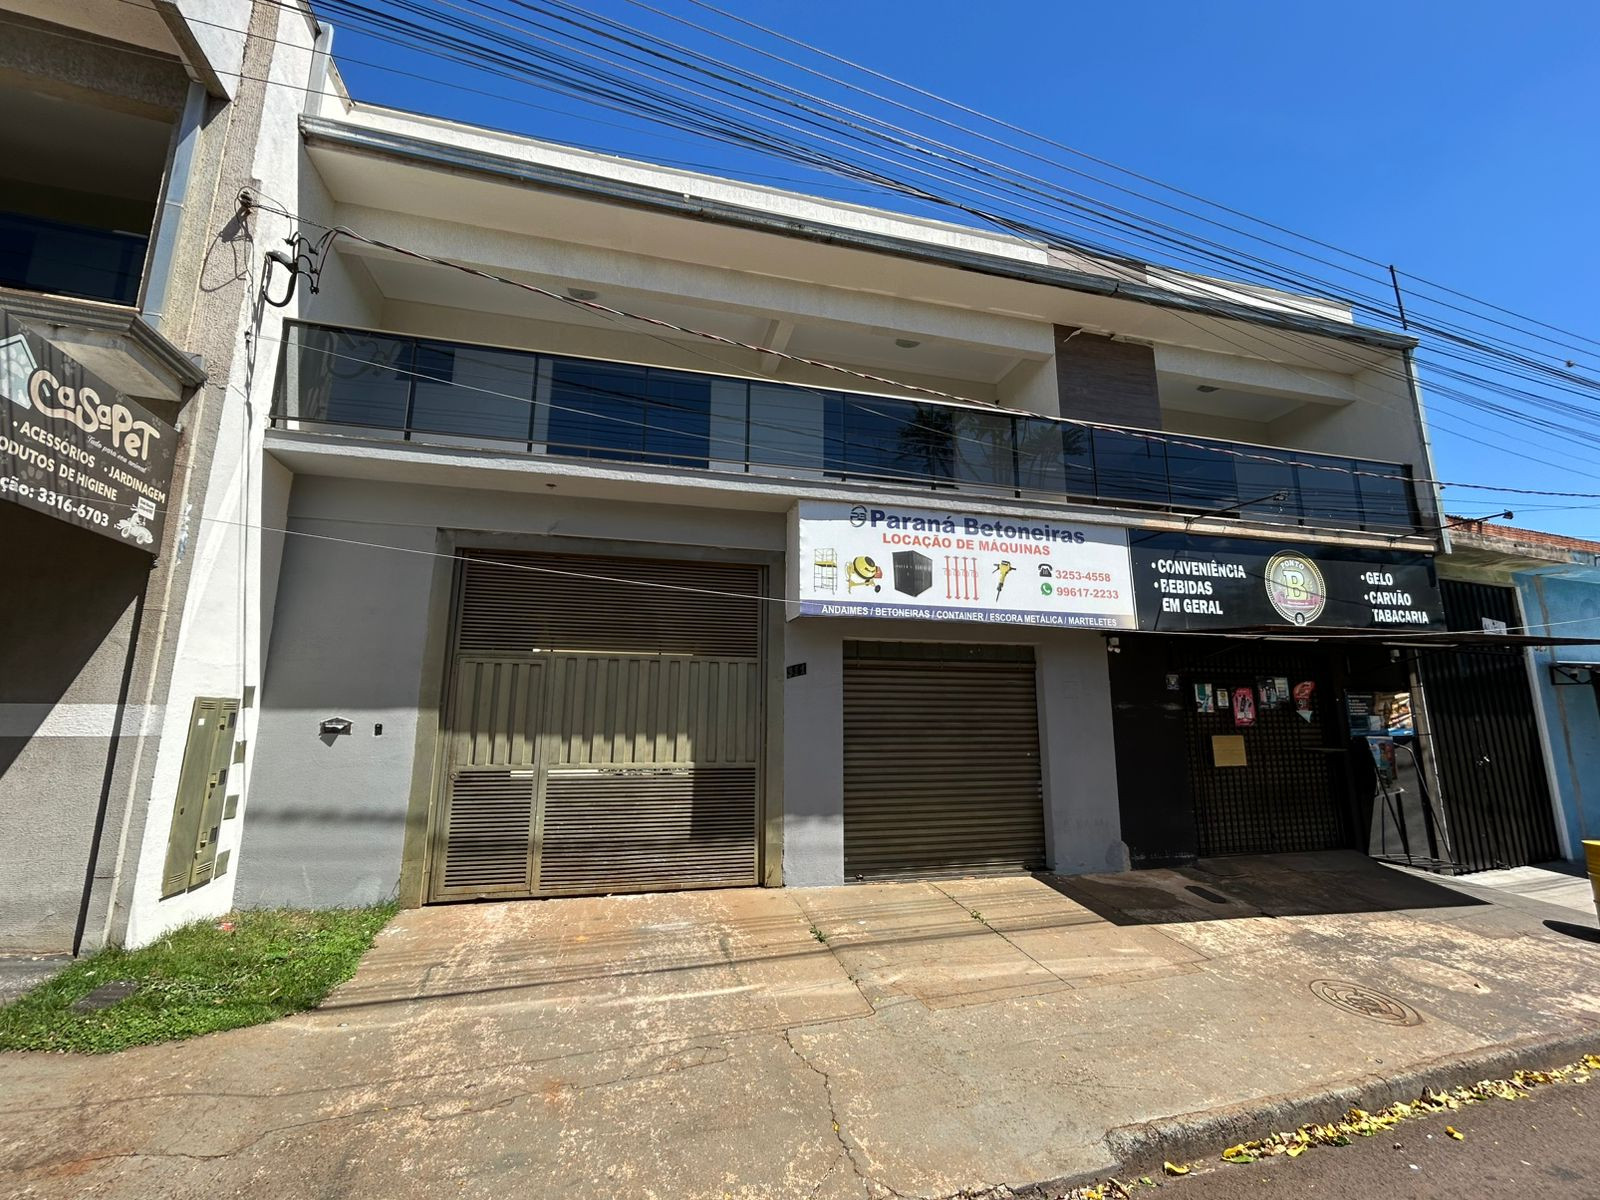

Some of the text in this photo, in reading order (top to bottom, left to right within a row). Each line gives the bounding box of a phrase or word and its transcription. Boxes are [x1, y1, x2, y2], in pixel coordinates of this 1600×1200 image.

[19, 421, 166, 504] ACESSÓRIOS JARDINAGEM
[58, 463, 76, 482] DE
[76, 471, 118, 501] HIGIENE
[37, 486, 110, 527] 3316-6703
[870, 509, 955, 534] Paraná
[963, 517, 1085, 545] Betoneiras
[882, 533, 1050, 556] LOCAÇÃO DE MÁQUINAS
[1055, 569, 1111, 583] 3253-4558
[1157, 559, 1247, 579] CONVENIÊNCIA
[1366, 571, 1394, 586] GELO
[1056, 586, 1119, 600] 99617-2233
[1160, 579, 1214, 595] BEBIDAS
[1282, 569, 1309, 601] B
[1162, 597, 1224, 615] EM GERAL
[1369, 589, 1412, 607] CARVÃO
[821, 604, 869, 616] ANDAIMES
[875, 607, 930, 618] BETONEIRAS
[936, 610, 984, 621] CONTAINER
[990, 613, 1023, 623] ESCORA
[1024, 612, 1063, 625] METÁLICA
[1068, 615, 1117, 627] MARTELETES
[1371, 608, 1430, 625] TABACARIA
